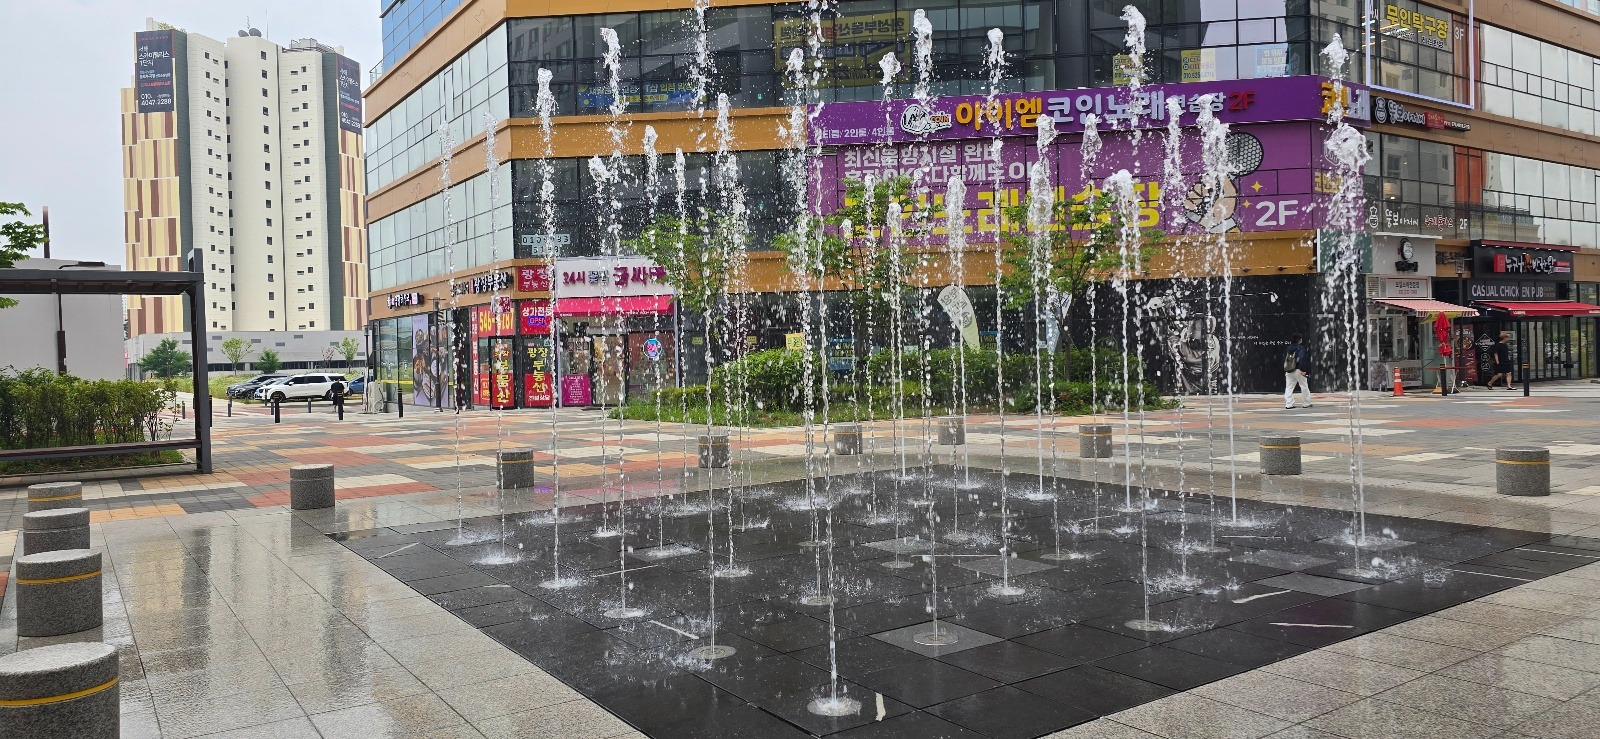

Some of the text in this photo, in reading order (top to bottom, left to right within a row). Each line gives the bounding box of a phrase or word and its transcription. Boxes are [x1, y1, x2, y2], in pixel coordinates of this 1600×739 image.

[1386, 4, 1449, 39] 무인탁구장
[1454, 26, 1464, 40] 3F
[1228, 90, 1256, 111] 2F
[1255, 200, 1299, 227] 2F
[1385, 208, 1419, 228] 뚱보아저씨
[1459, 218, 1468, 230] 2F
[562, 271, 586, 285] 24시
[1471, 285, 1499, 297] CASUAL
[527, 347, 549, 358] 광장
[532, 360, 549, 393] 부동산
